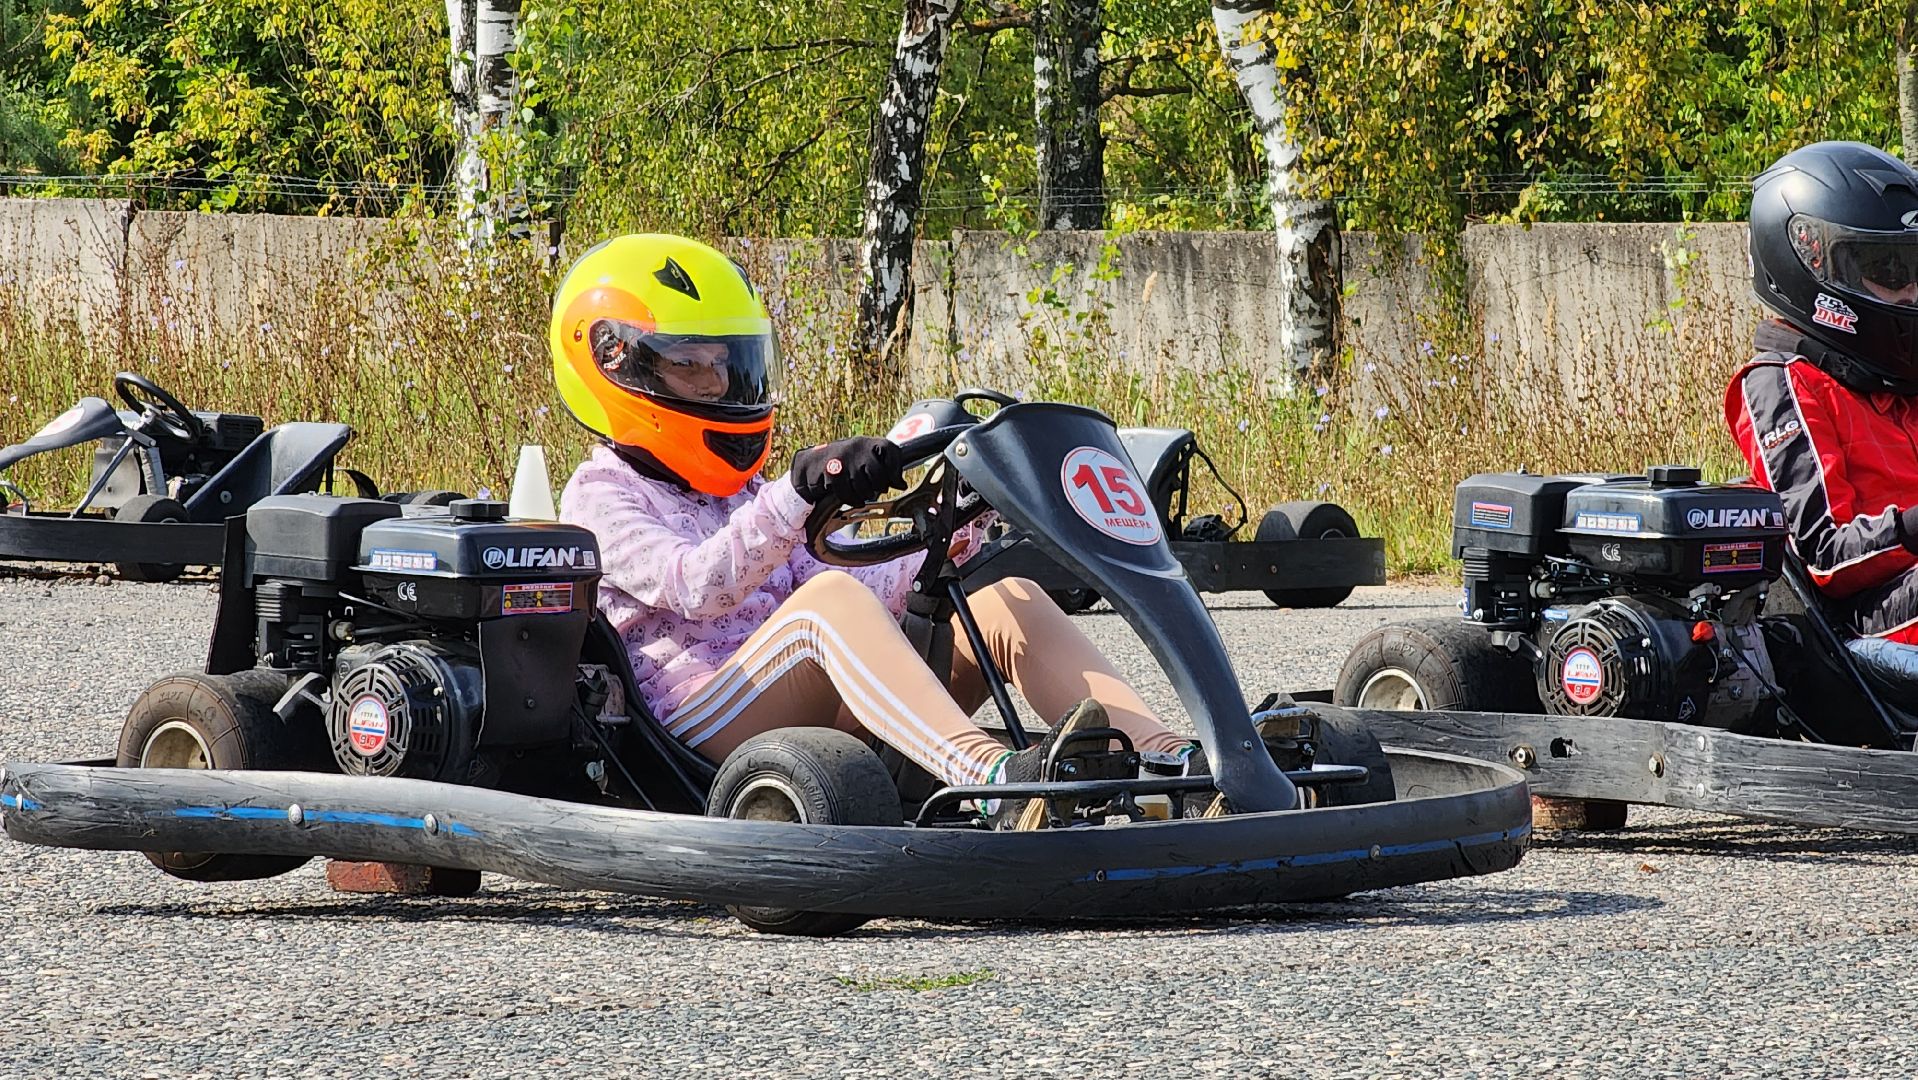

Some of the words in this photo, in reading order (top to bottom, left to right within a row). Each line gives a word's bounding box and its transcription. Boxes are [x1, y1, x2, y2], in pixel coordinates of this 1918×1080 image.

[895, 418, 923, 440] 3
[1072, 464, 1146, 516] 15
[1707, 508, 1767, 528] LIFAN
[505, 547, 577, 567] LIFAN
[1601, 543, 1621, 561] CE
[397, 582, 417, 601] CE
